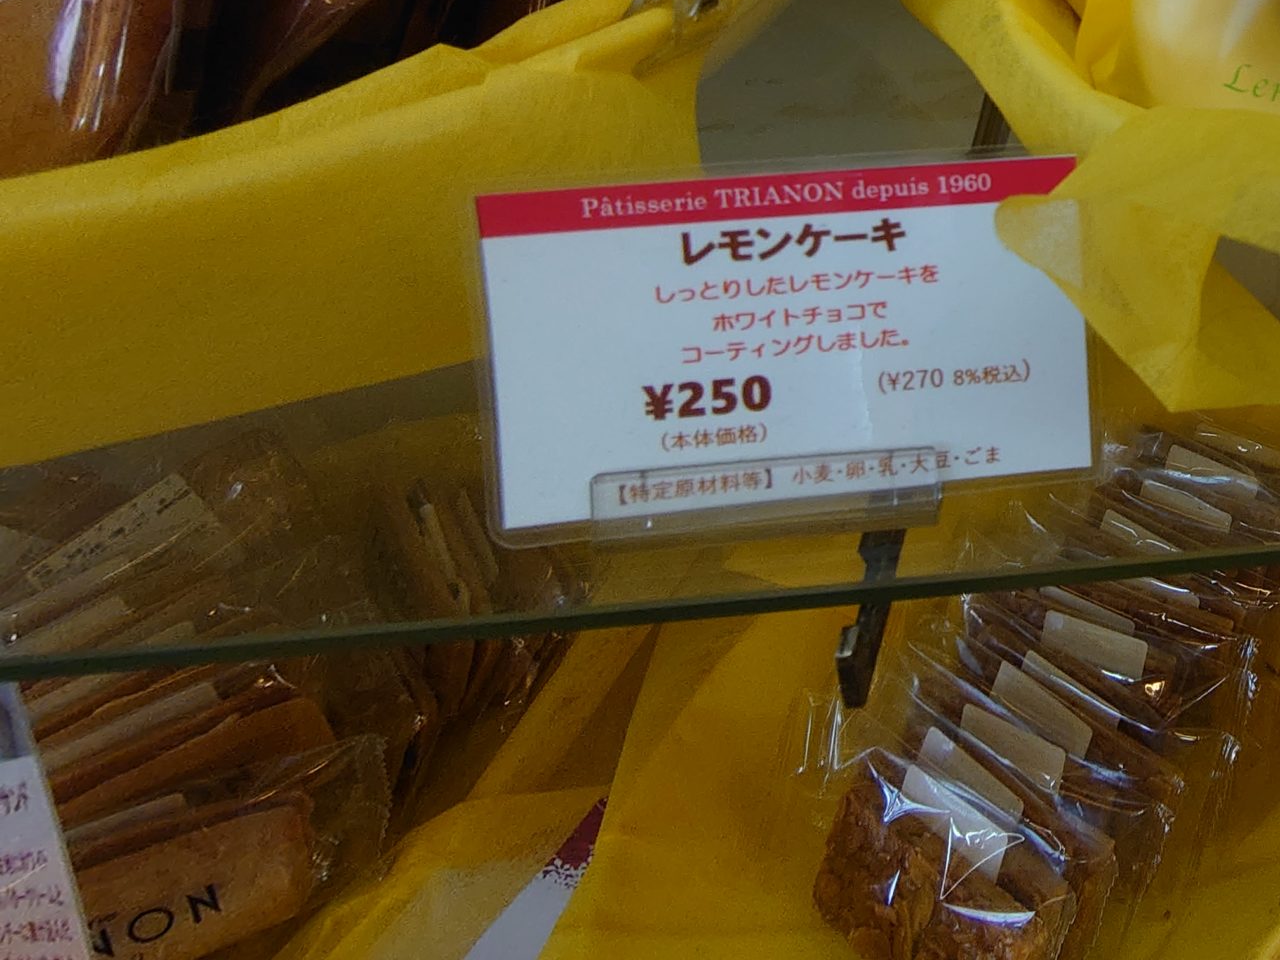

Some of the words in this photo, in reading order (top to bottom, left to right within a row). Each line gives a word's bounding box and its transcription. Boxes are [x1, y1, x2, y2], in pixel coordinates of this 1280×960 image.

[580, 192, 707, 219] Pâtisserie
[714, 182, 844, 210] TRIANON
[851, 178, 929, 204] depuis
[937, 173, 992, 194] 1960
[681, 218, 906, 266] レモンケーキ
[655, 264, 939, 304] しっとりしたレモンケーキを
[713, 300, 888, 332] ホワイトチョコで
[682, 328, 911, 364] コーティングしました。
[642, 375, 772, 421] ¥250
[661, 422, 768, 452] (本体価格)
[616, 466, 776, 506] 【特定原材料等】
